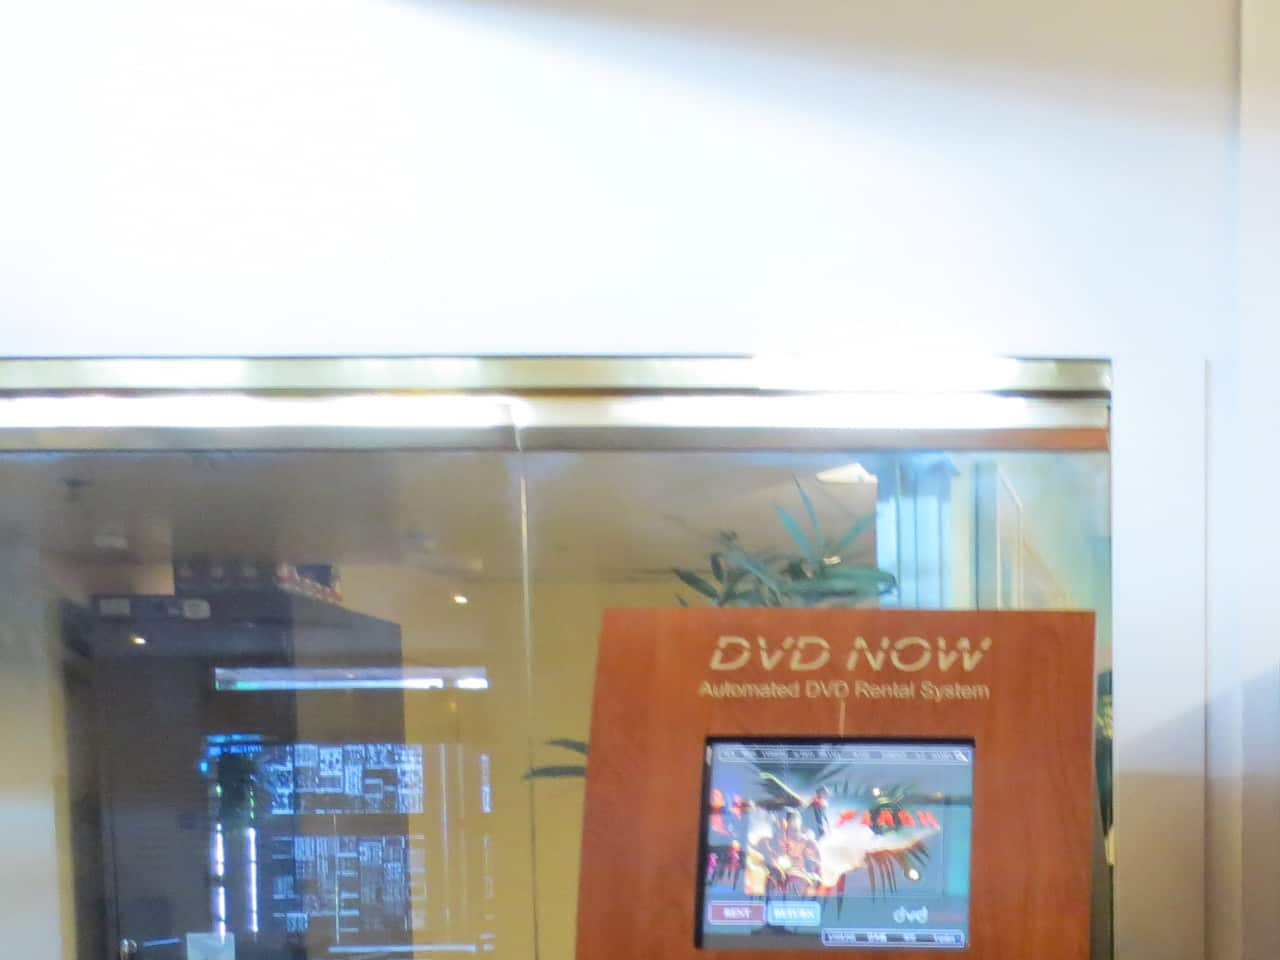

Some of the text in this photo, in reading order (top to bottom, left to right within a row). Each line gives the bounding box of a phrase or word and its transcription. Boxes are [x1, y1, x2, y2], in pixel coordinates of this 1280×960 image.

[709, 635, 993, 672] DVD NOW
[697, 680, 991, 703] Automated DVD Rental System
